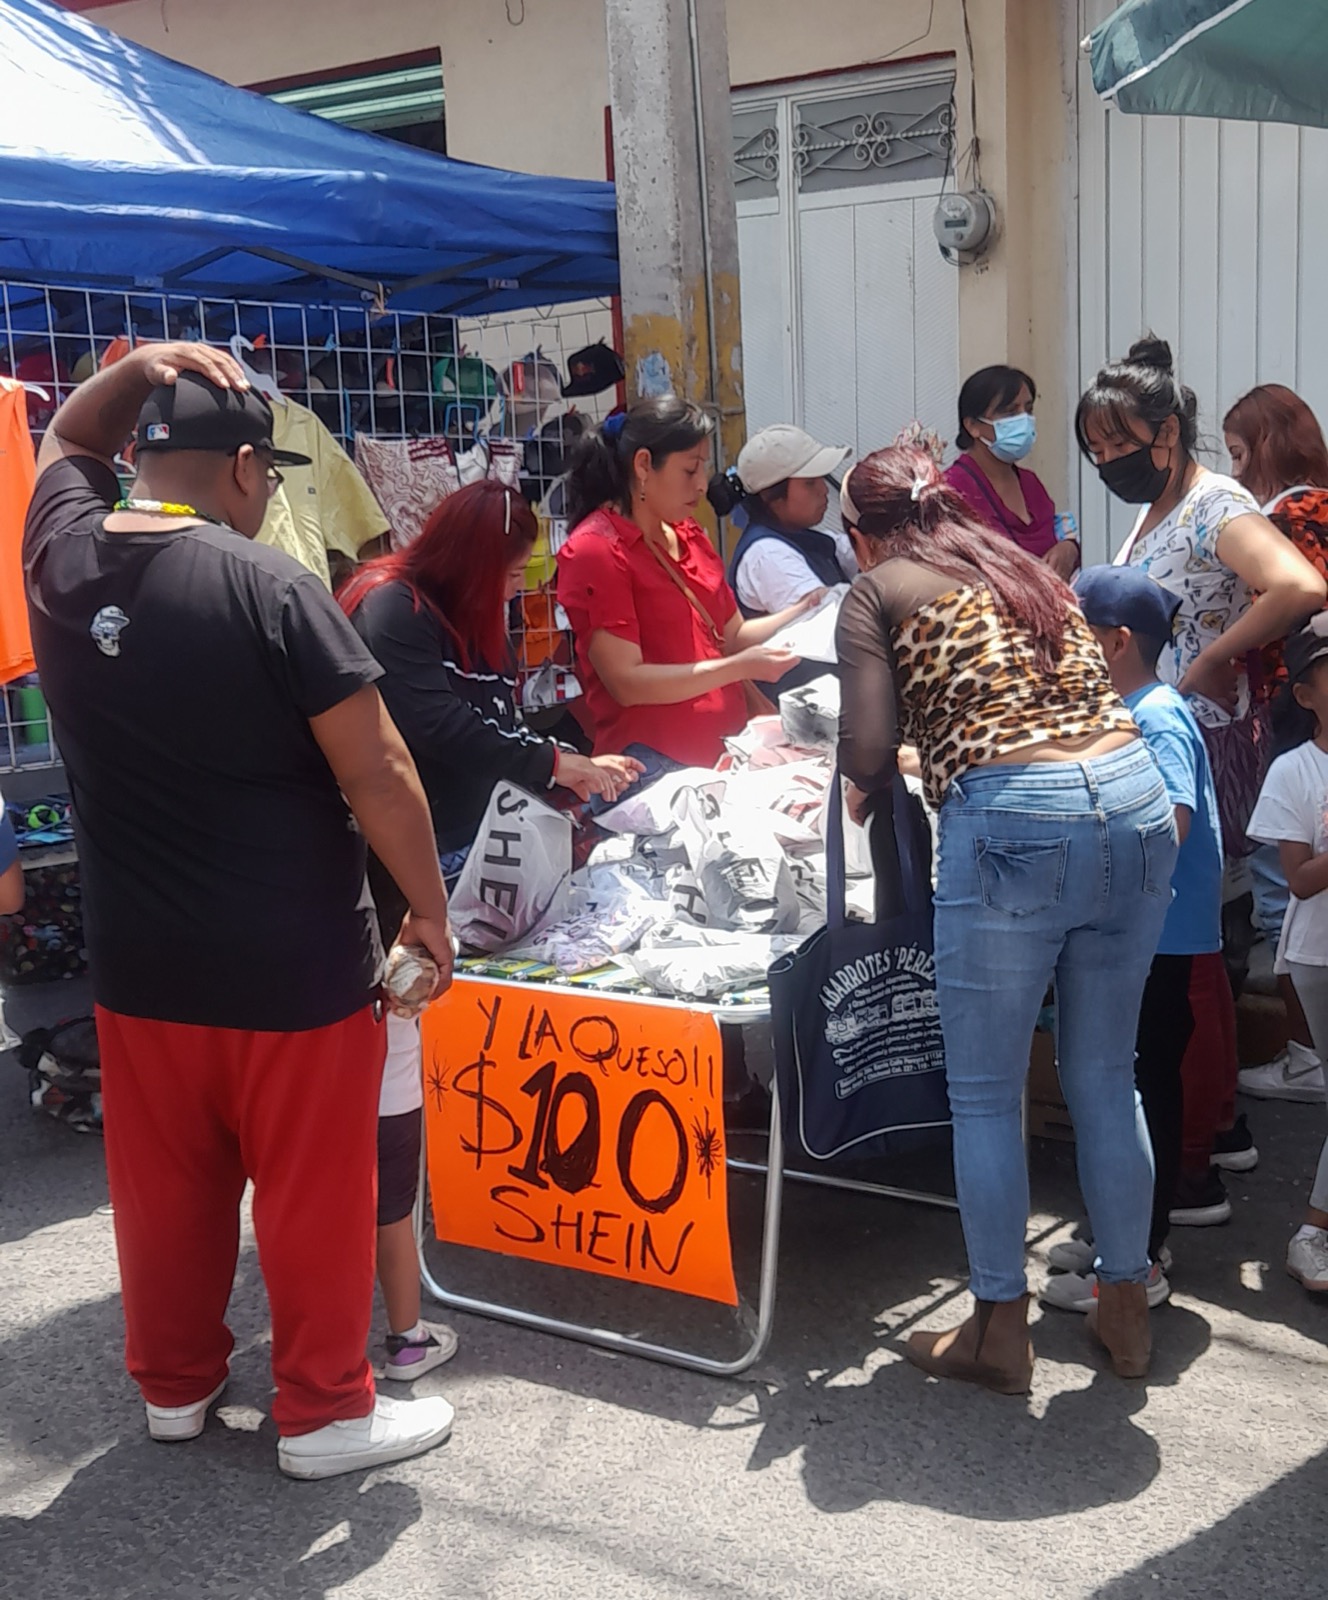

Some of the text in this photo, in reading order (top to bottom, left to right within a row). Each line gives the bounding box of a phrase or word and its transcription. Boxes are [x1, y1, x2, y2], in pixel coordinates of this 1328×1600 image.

[818, 949, 890, 1012] ABARROTES
[477, 995, 502, 1051] Y
[518, 1004, 563, 1060] LA
[452, 1050, 689, 1214] $100
[490, 1185, 694, 1275] SHEIN
